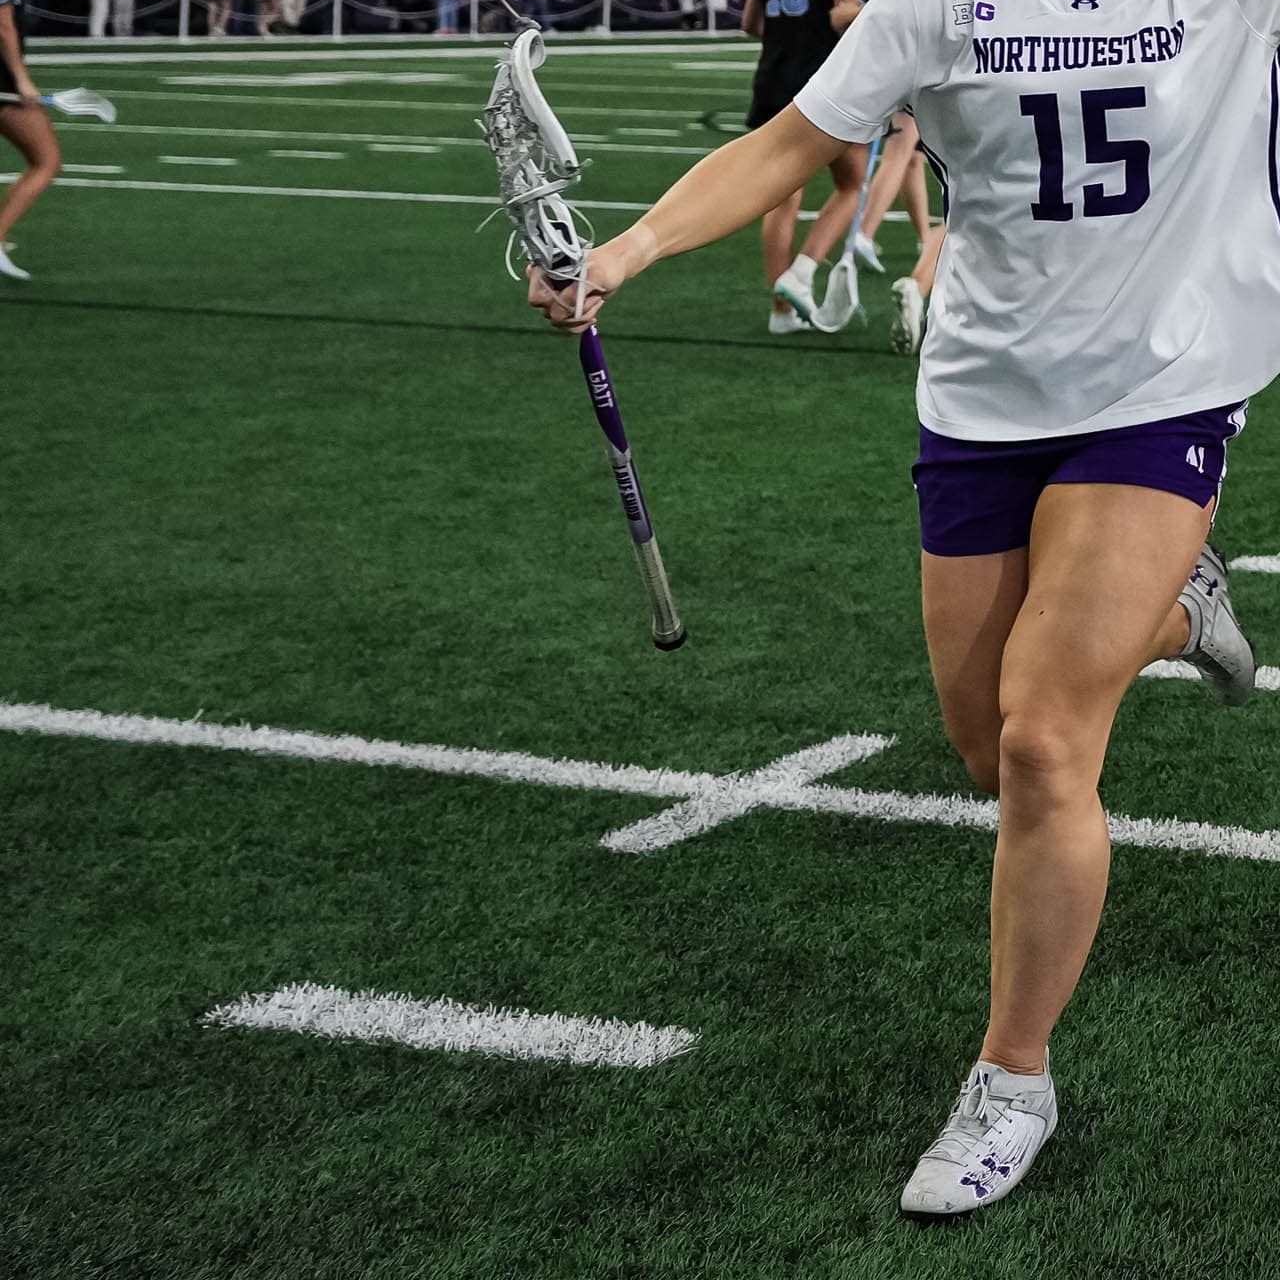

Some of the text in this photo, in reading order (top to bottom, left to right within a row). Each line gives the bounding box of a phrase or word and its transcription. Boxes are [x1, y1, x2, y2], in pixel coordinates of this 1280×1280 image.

[973, 20, 1185, 74] NORTHWESTERN
[1019, 86, 1150, 222] 15
[588, 370, 614, 408] GAIT
